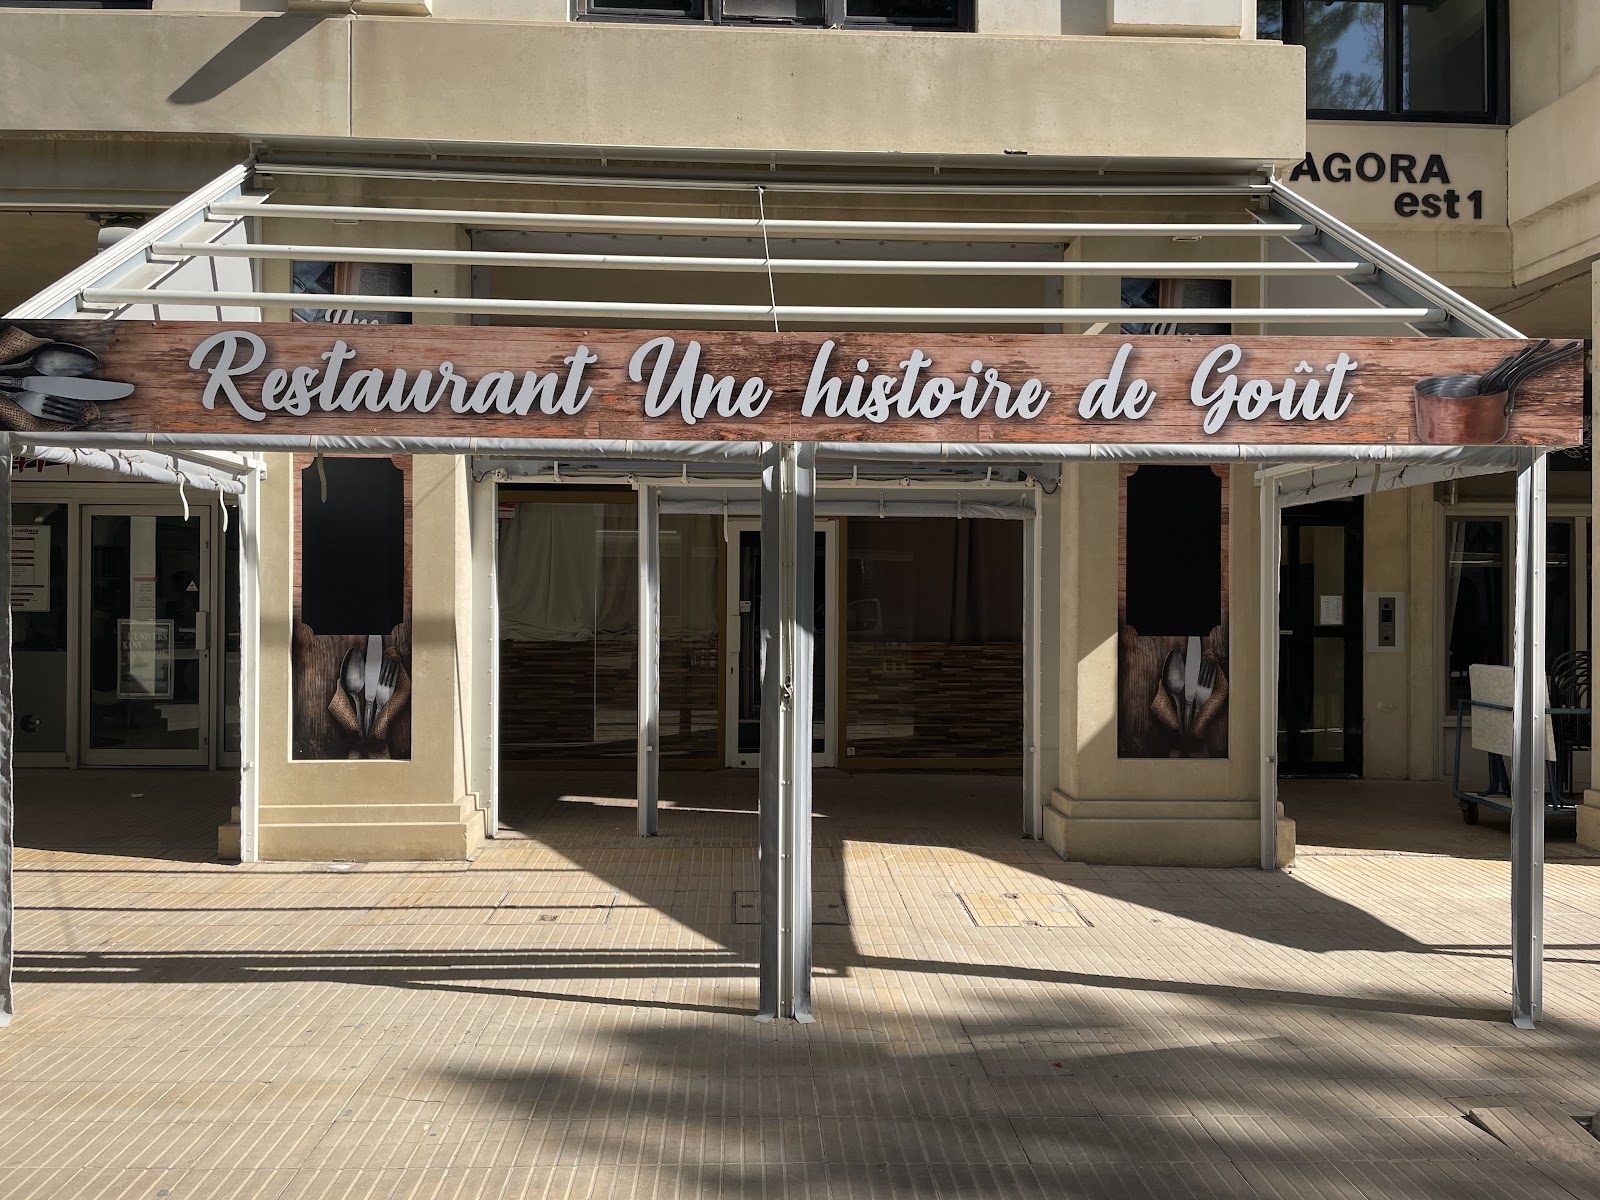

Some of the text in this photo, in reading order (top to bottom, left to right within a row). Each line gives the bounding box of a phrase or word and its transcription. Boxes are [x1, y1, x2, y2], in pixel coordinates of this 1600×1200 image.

[1289, 151, 1450, 184] AGORA
[1394, 189, 1482, 219] est 1
[188, 330, 1358, 434] Restaurant Une histoire de Goût
